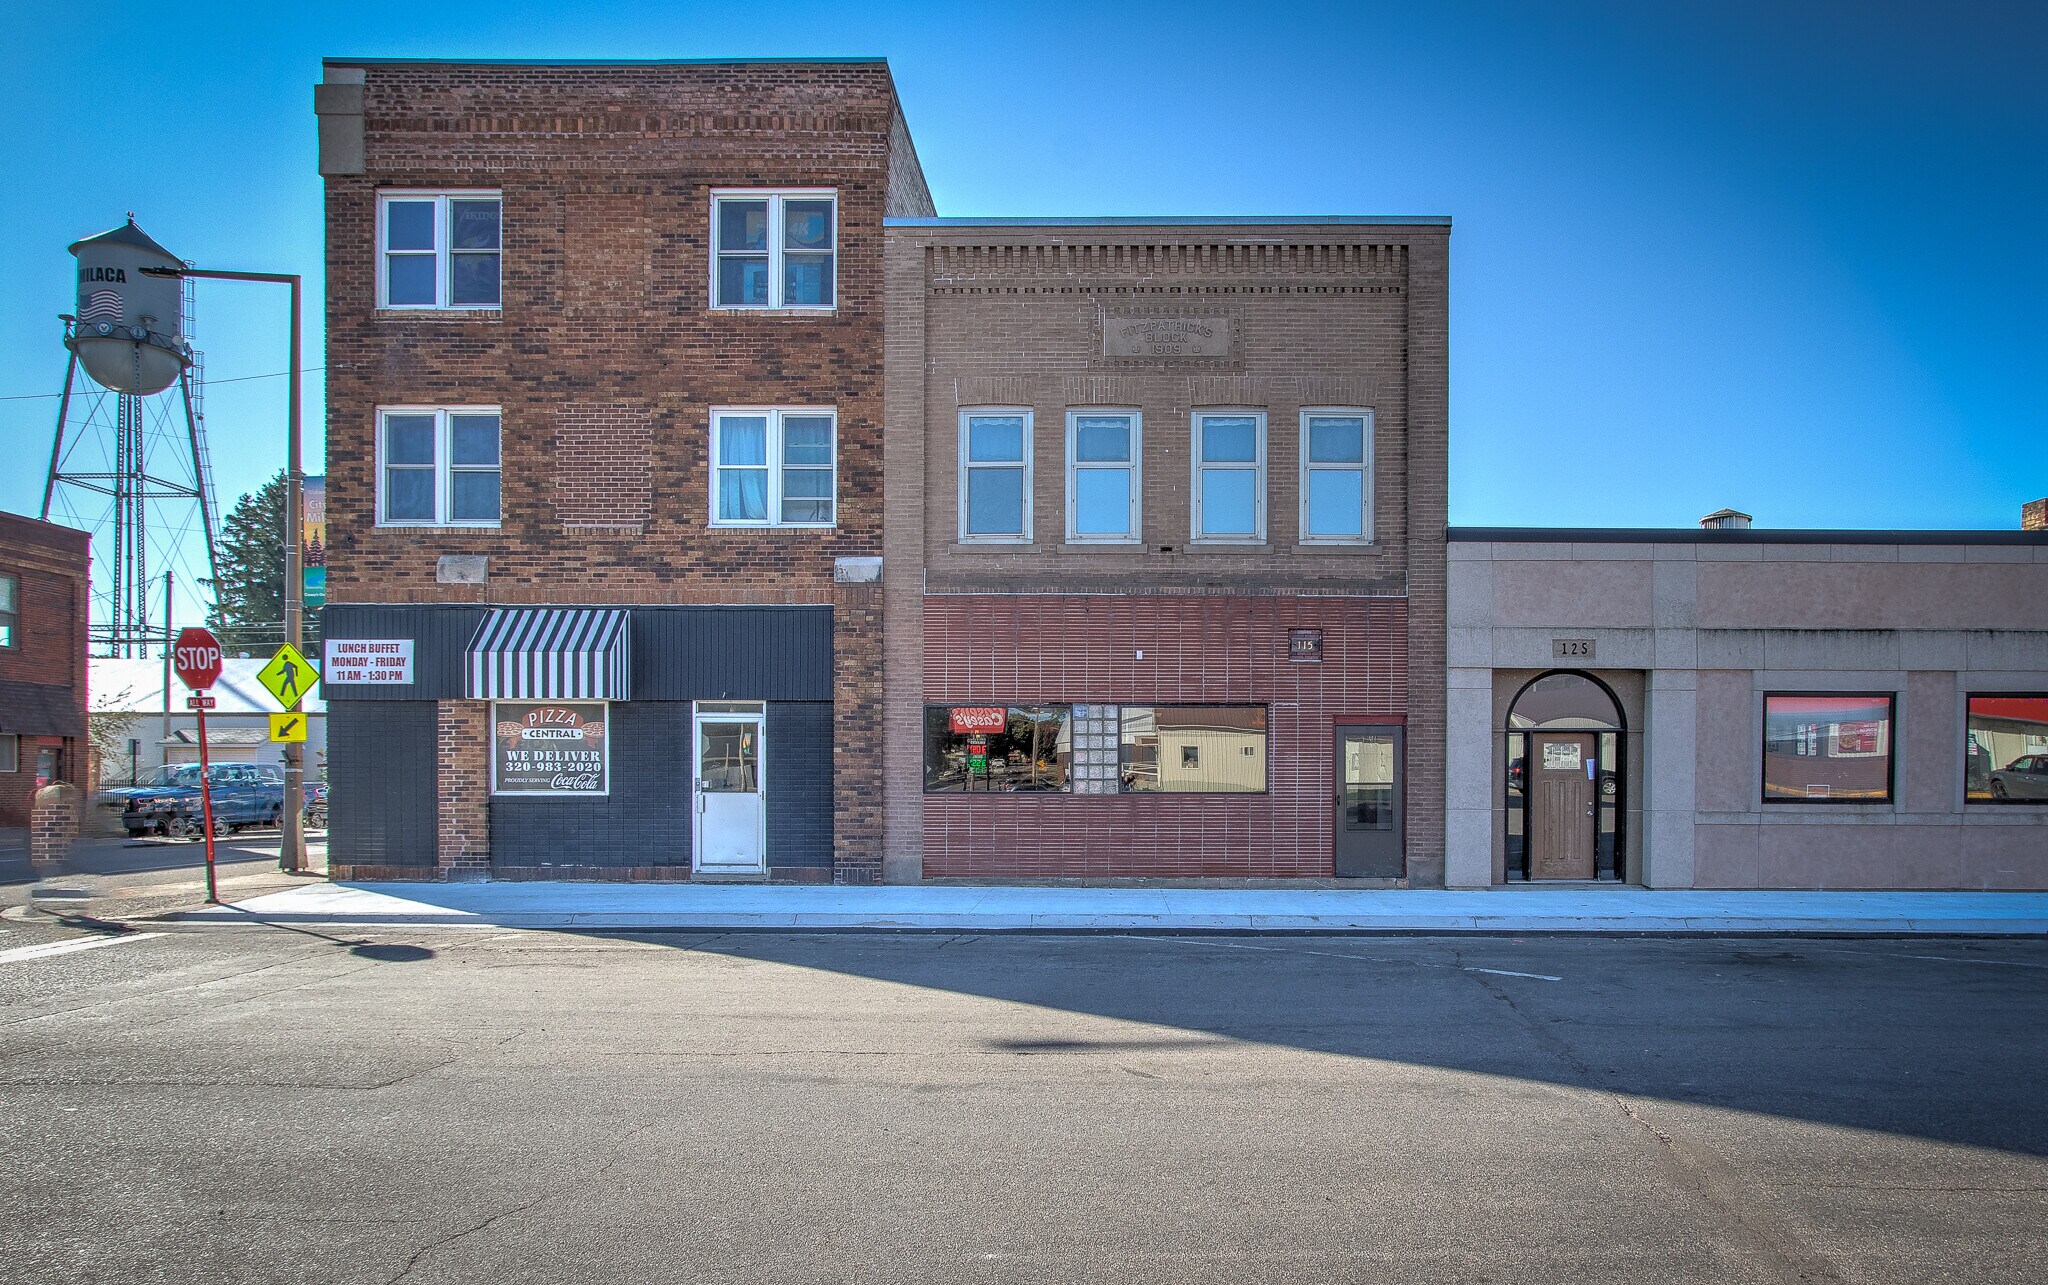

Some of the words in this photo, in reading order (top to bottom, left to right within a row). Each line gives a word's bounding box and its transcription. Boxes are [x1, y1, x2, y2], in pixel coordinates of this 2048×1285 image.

[1145, 332, 1188, 343] BLOCK
[1151, 345, 1182, 354] 1909
[338, 643, 367, 653] LUNCH
[369, 643, 400, 653] BUFFET
[1297, 640, 1313, 650] 115
[1562, 642, 1588, 655] 125
[176, 646, 219, 671] STOP
[331, 657, 368, 667] MONDAY
[375, 657, 406, 667] FRIDAY
[337, 671, 345, 681] 11
[347, 671, 361, 681] AM
[368, 671, 387, 681] 1:30
[389, 671, 403, 681] PM
[189, 698, 200, 707] ALL
[202, 698, 214, 707] WAY
[528, 709, 577, 727] PIZZA
[529, 730, 576, 738] CENTRAL
[506, 750, 530, 762] WE
[534, 750, 601, 762] DELIVER
[505, 761, 602, 772] 320-983-2020
